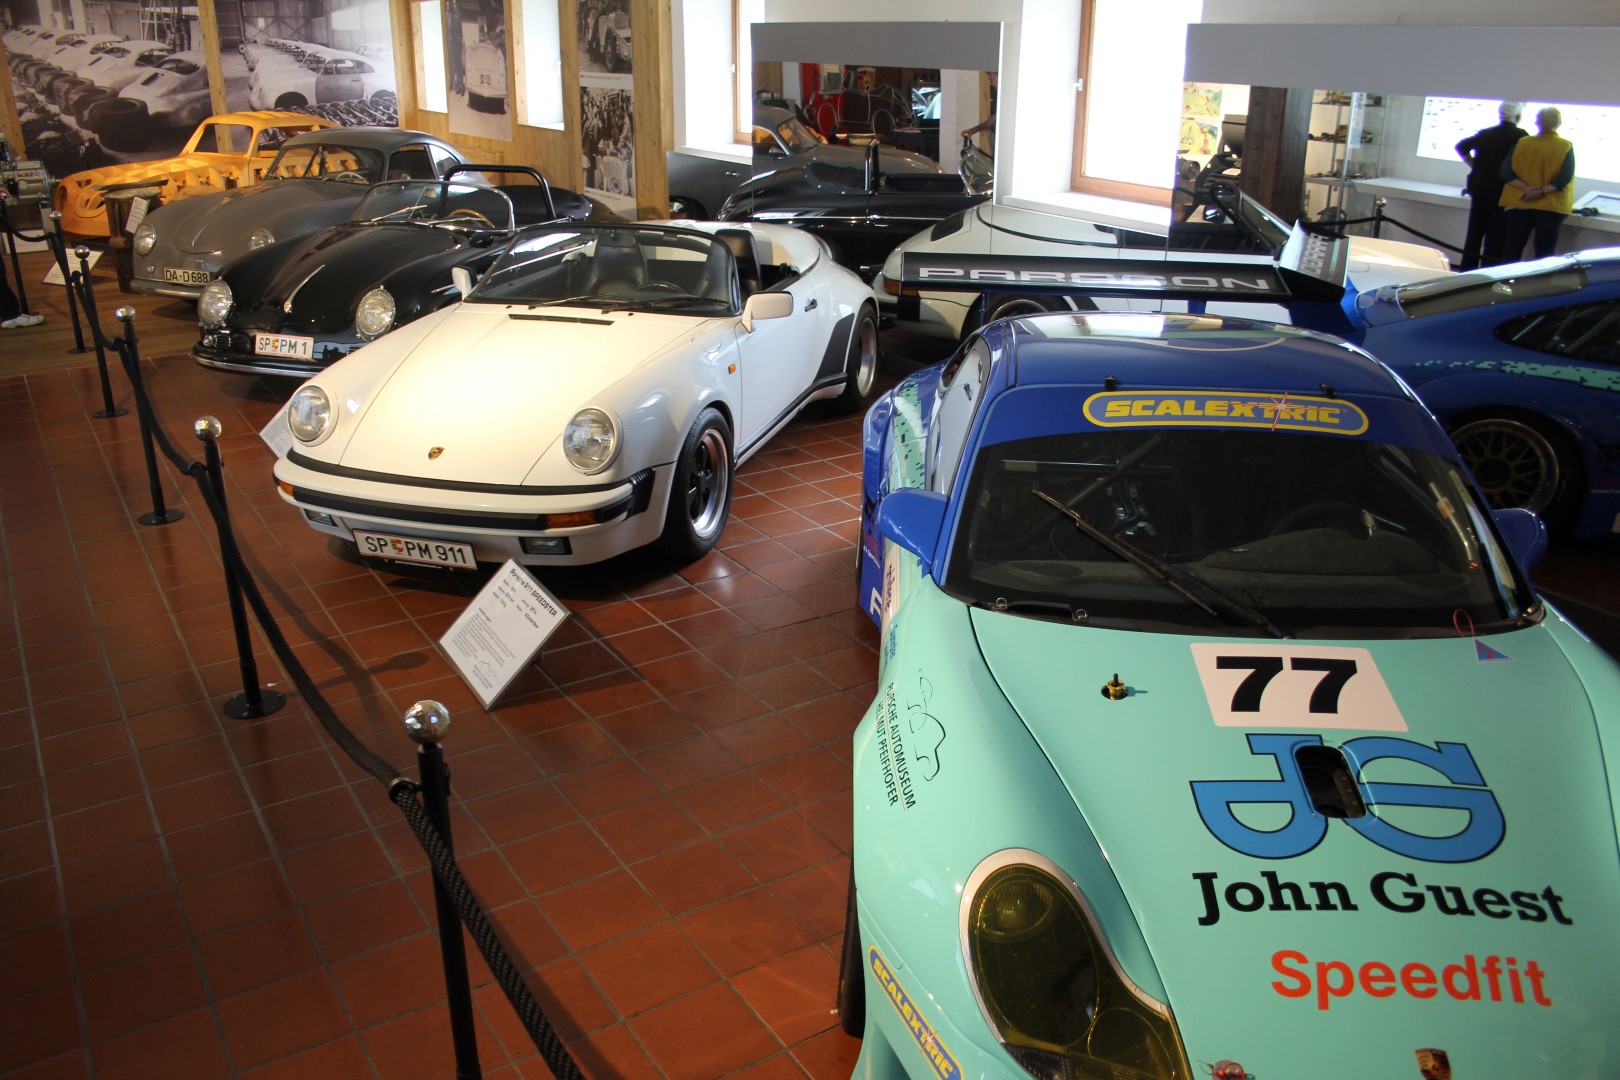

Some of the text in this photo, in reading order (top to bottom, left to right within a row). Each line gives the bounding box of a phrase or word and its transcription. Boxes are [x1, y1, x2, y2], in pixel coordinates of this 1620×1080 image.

[191, 271, 209, 284] 688
[919, 267, 1271, 291] PARAGON
[258, 337, 308, 355] SP PM 1
[1105, 399, 1340, 424] SCALEXTRIC
[365, 535, 466, 564] SP PM 911
[510, 568, 526, 586] Porsche
[531, 590, 558, 617] SPEEDSTER
[886, 682, 898, 724] PORSCHE
[1216, 655, 1358, 714] 77
[876, 700, 899, 807] HELMUT PFEIFHOFER
[890, 724, 916, 809] AUTOMUSEUM
[1192, 870, 1573, 926] John Guest
[1270, 949, 1552, 1011] Speedfit
[873, 958, 954, 1079] SCALEXTRIC
